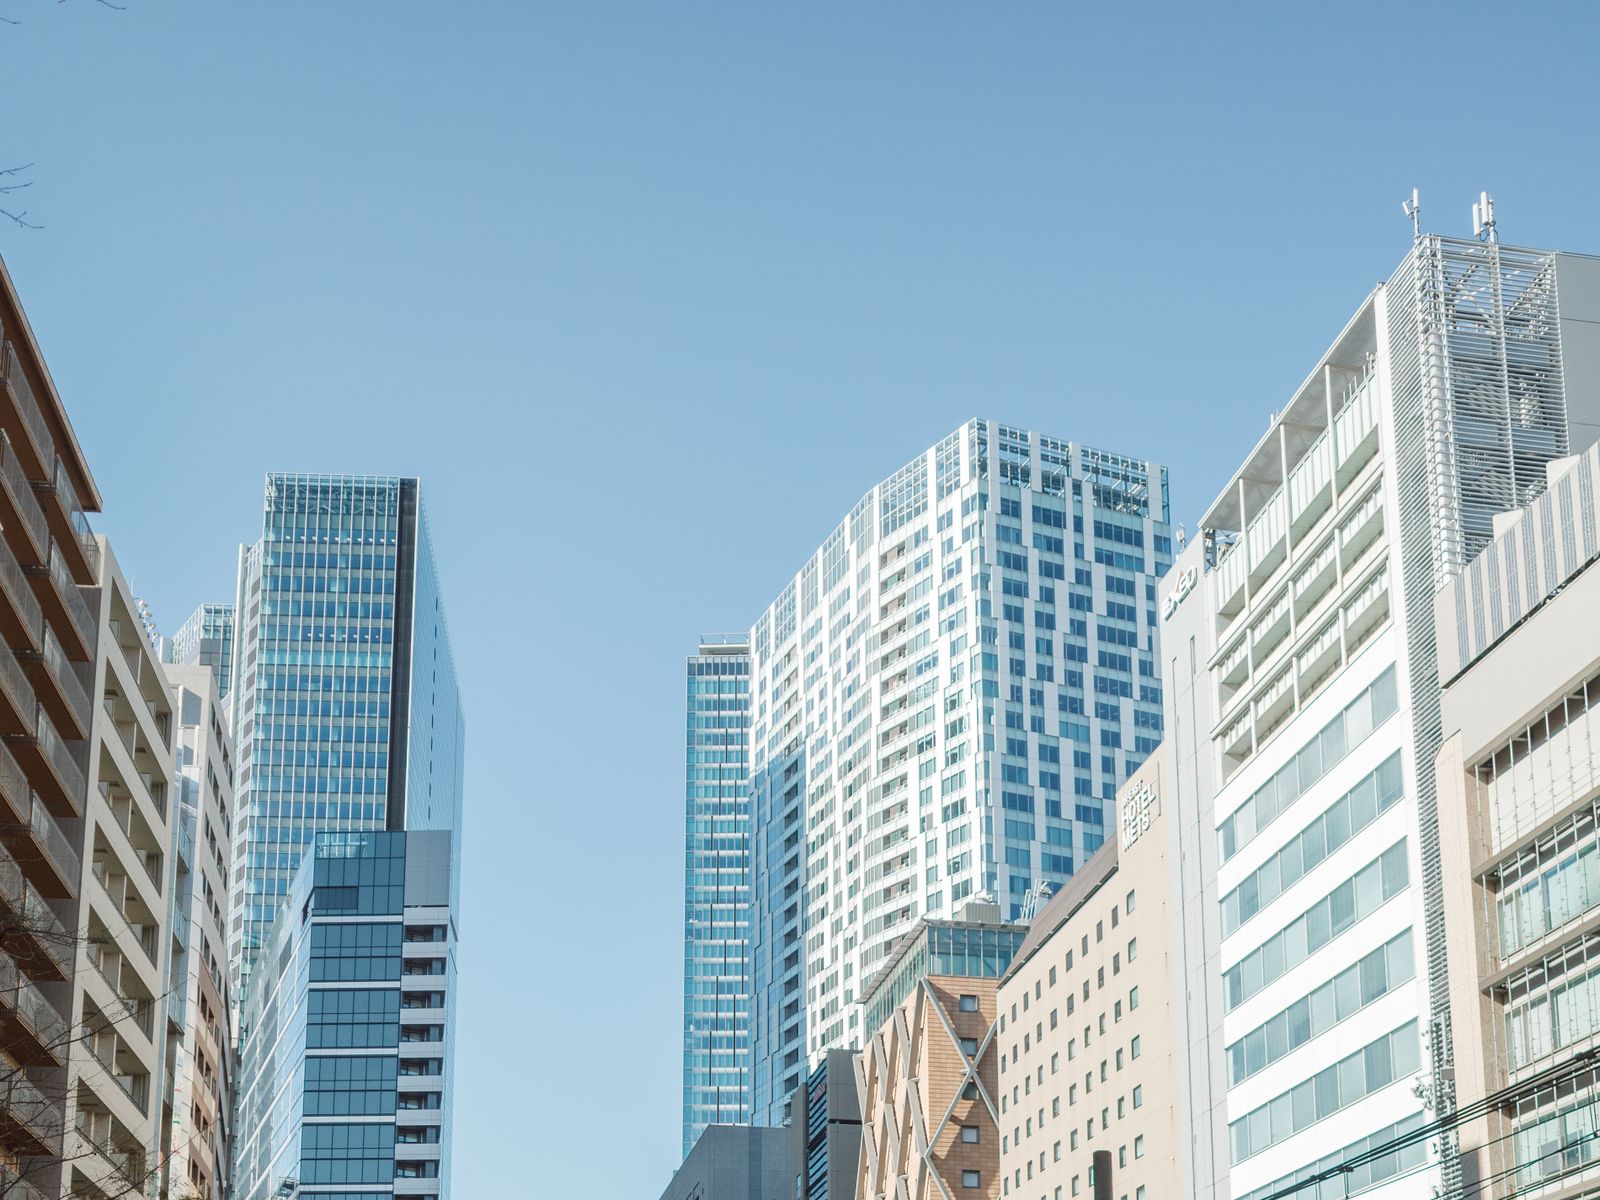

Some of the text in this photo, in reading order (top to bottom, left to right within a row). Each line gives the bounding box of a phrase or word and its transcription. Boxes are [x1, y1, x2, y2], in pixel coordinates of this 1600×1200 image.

[1160, 565, 1198, 622] EXEO
[1121, 784, 1156, 831] HOTEL
[1123, 809, 1150, 852] METS
